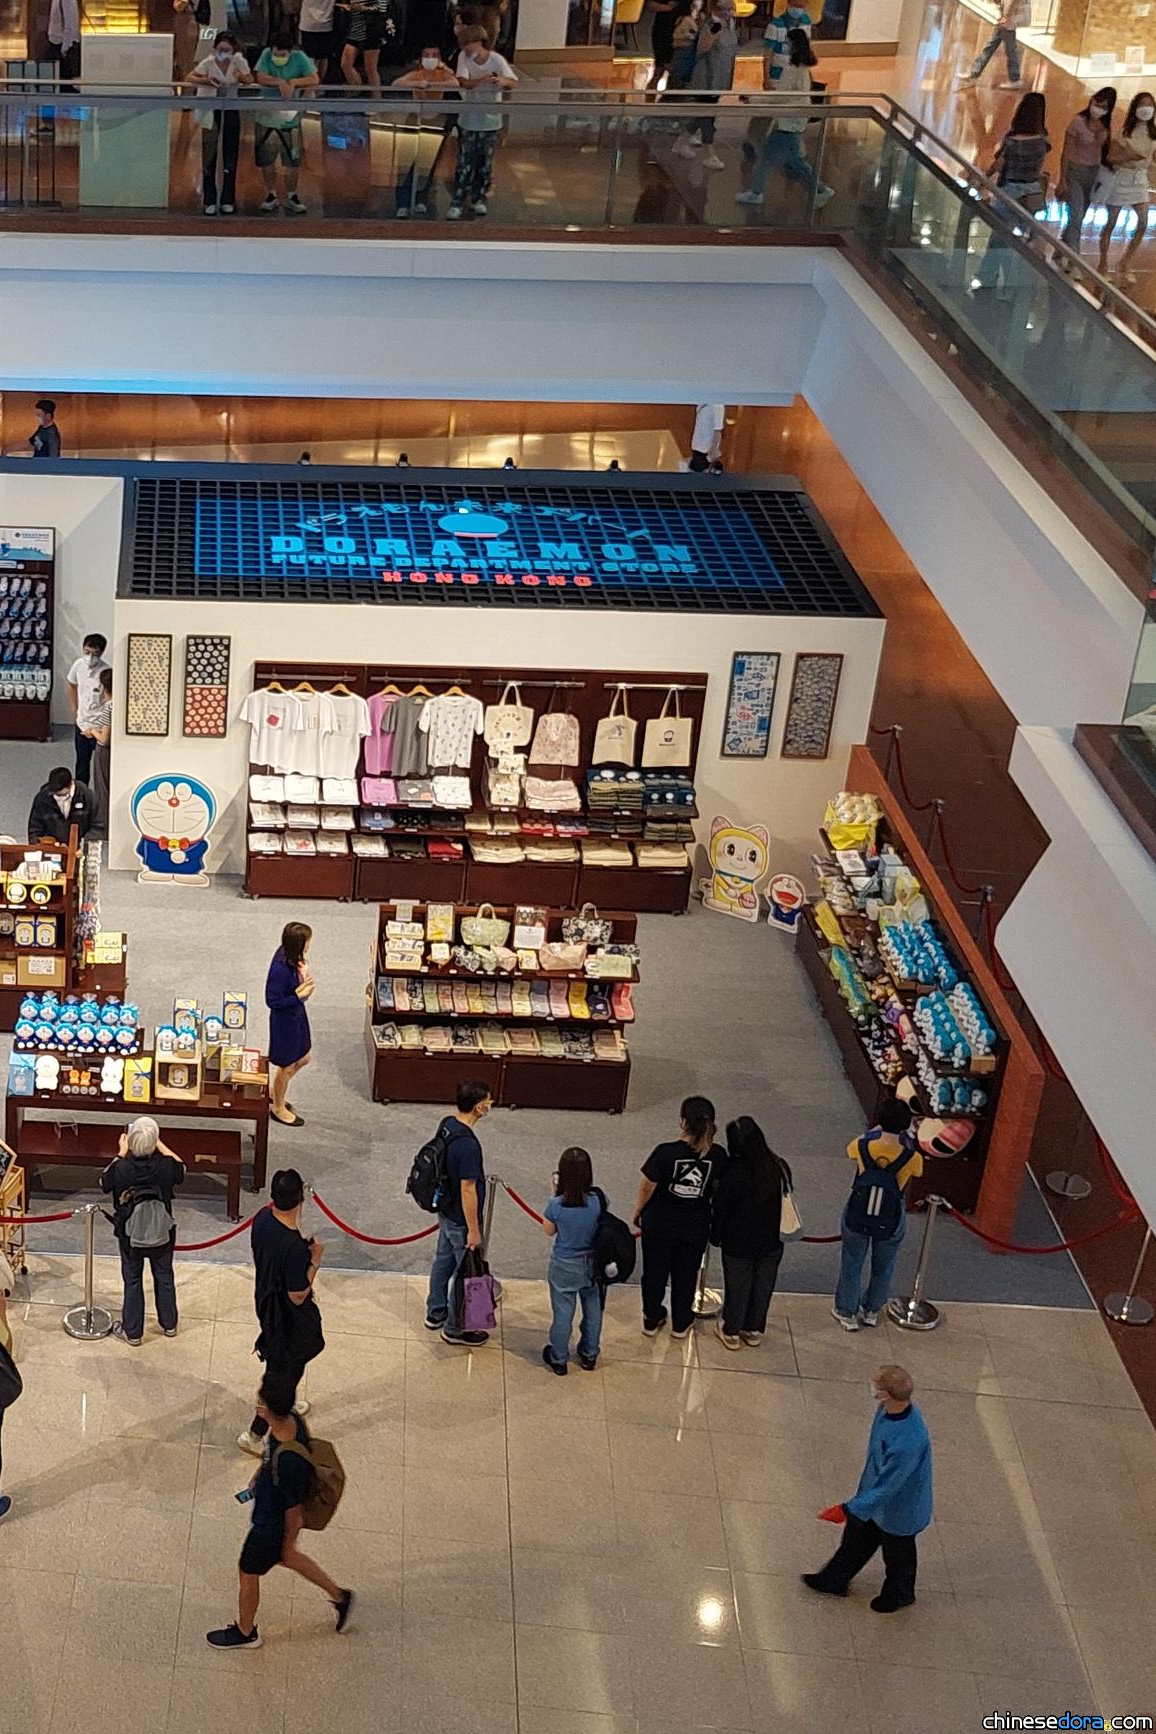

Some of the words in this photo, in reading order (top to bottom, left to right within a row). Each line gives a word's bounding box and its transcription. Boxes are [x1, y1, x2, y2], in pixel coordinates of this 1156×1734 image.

[271, 536, 692, 562] DORAEMON
[271, 554, 387, 567] FUTURE
[394, 556, 592, 571] DEPARTMENT
[600, 562, 699, 574] STORE
[382, 571, 481, 585] HONG
[494, 573, 593, 587] KONG
